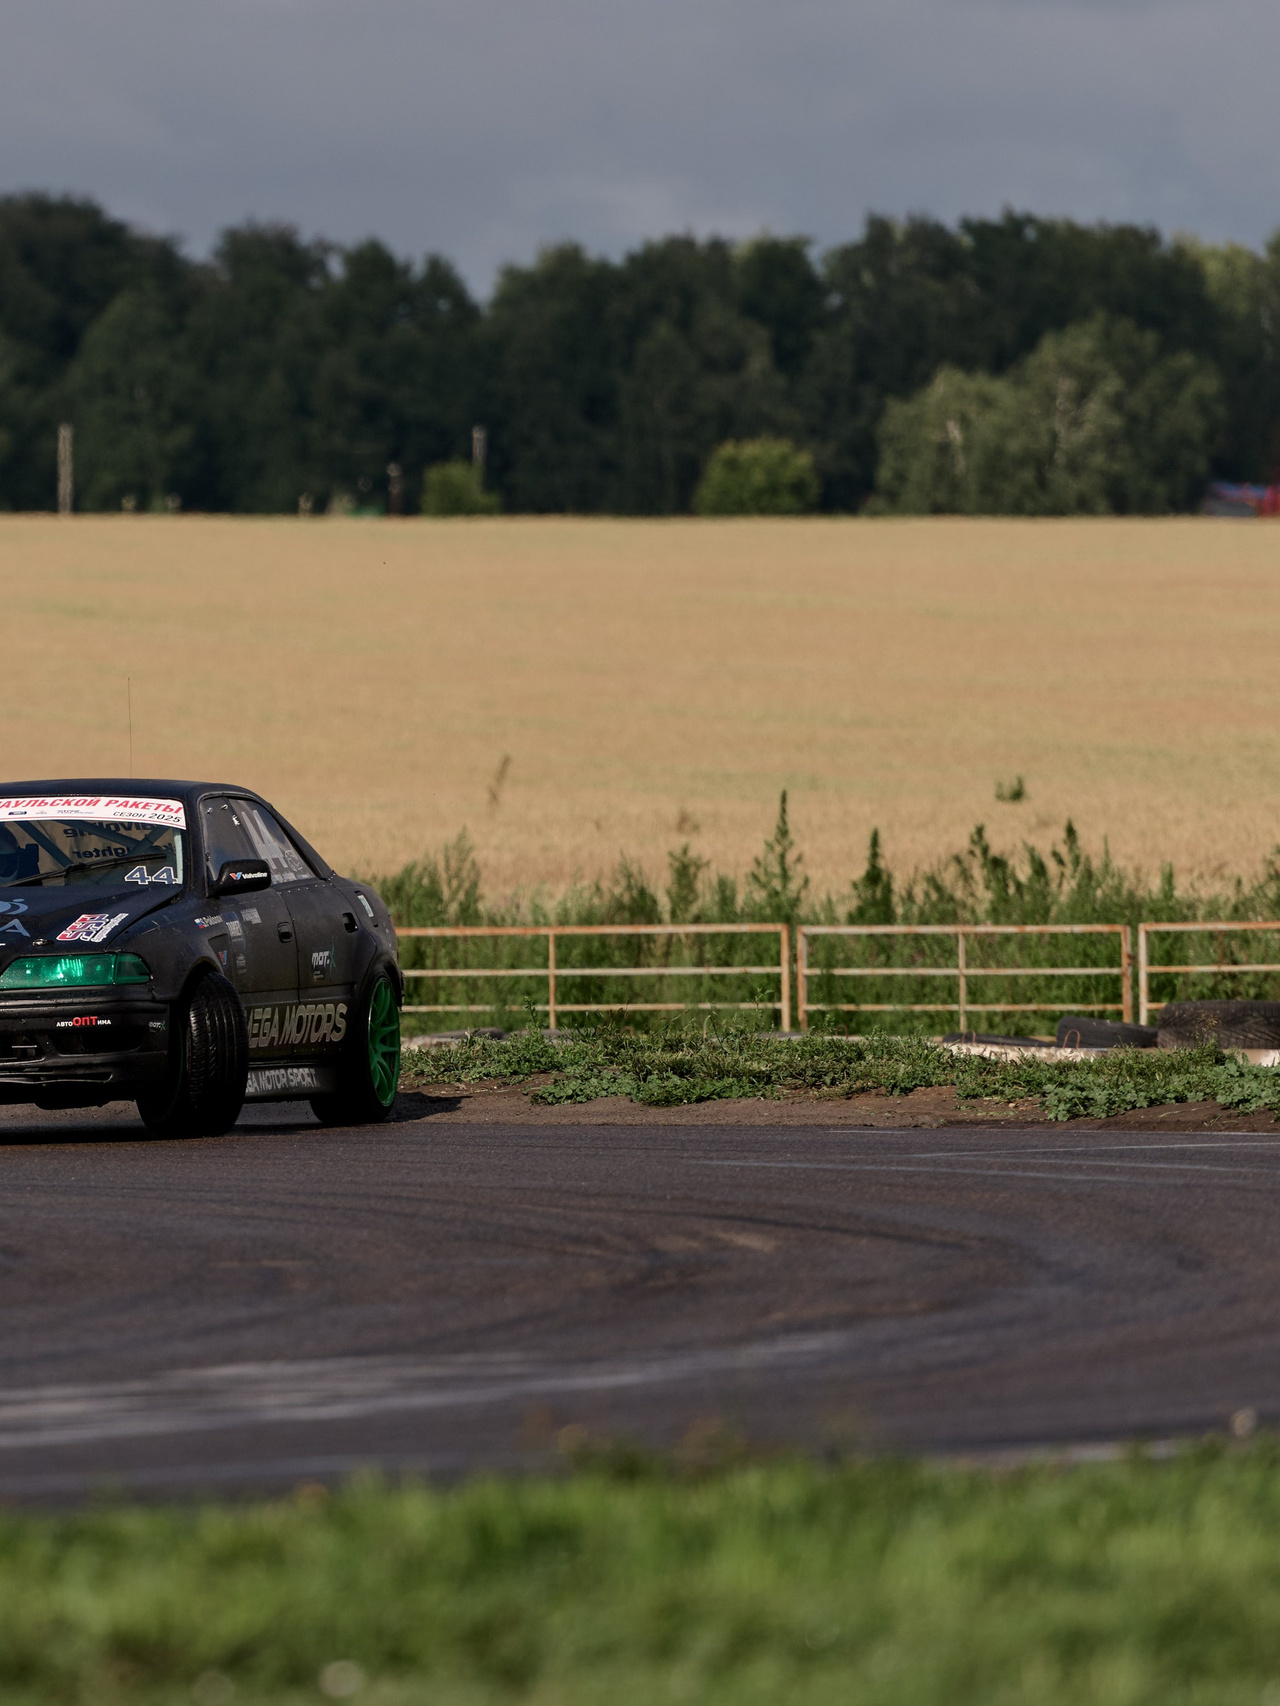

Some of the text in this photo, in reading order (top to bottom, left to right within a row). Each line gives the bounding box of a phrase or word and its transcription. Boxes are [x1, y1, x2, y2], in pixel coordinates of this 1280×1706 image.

[104, 799, 183, 814] РАКЕТЫ
[148, 812, 183, 823] 2025
[124, 865, 178, 885] 44
[279, 1003, 348, 1044] MOTORS
